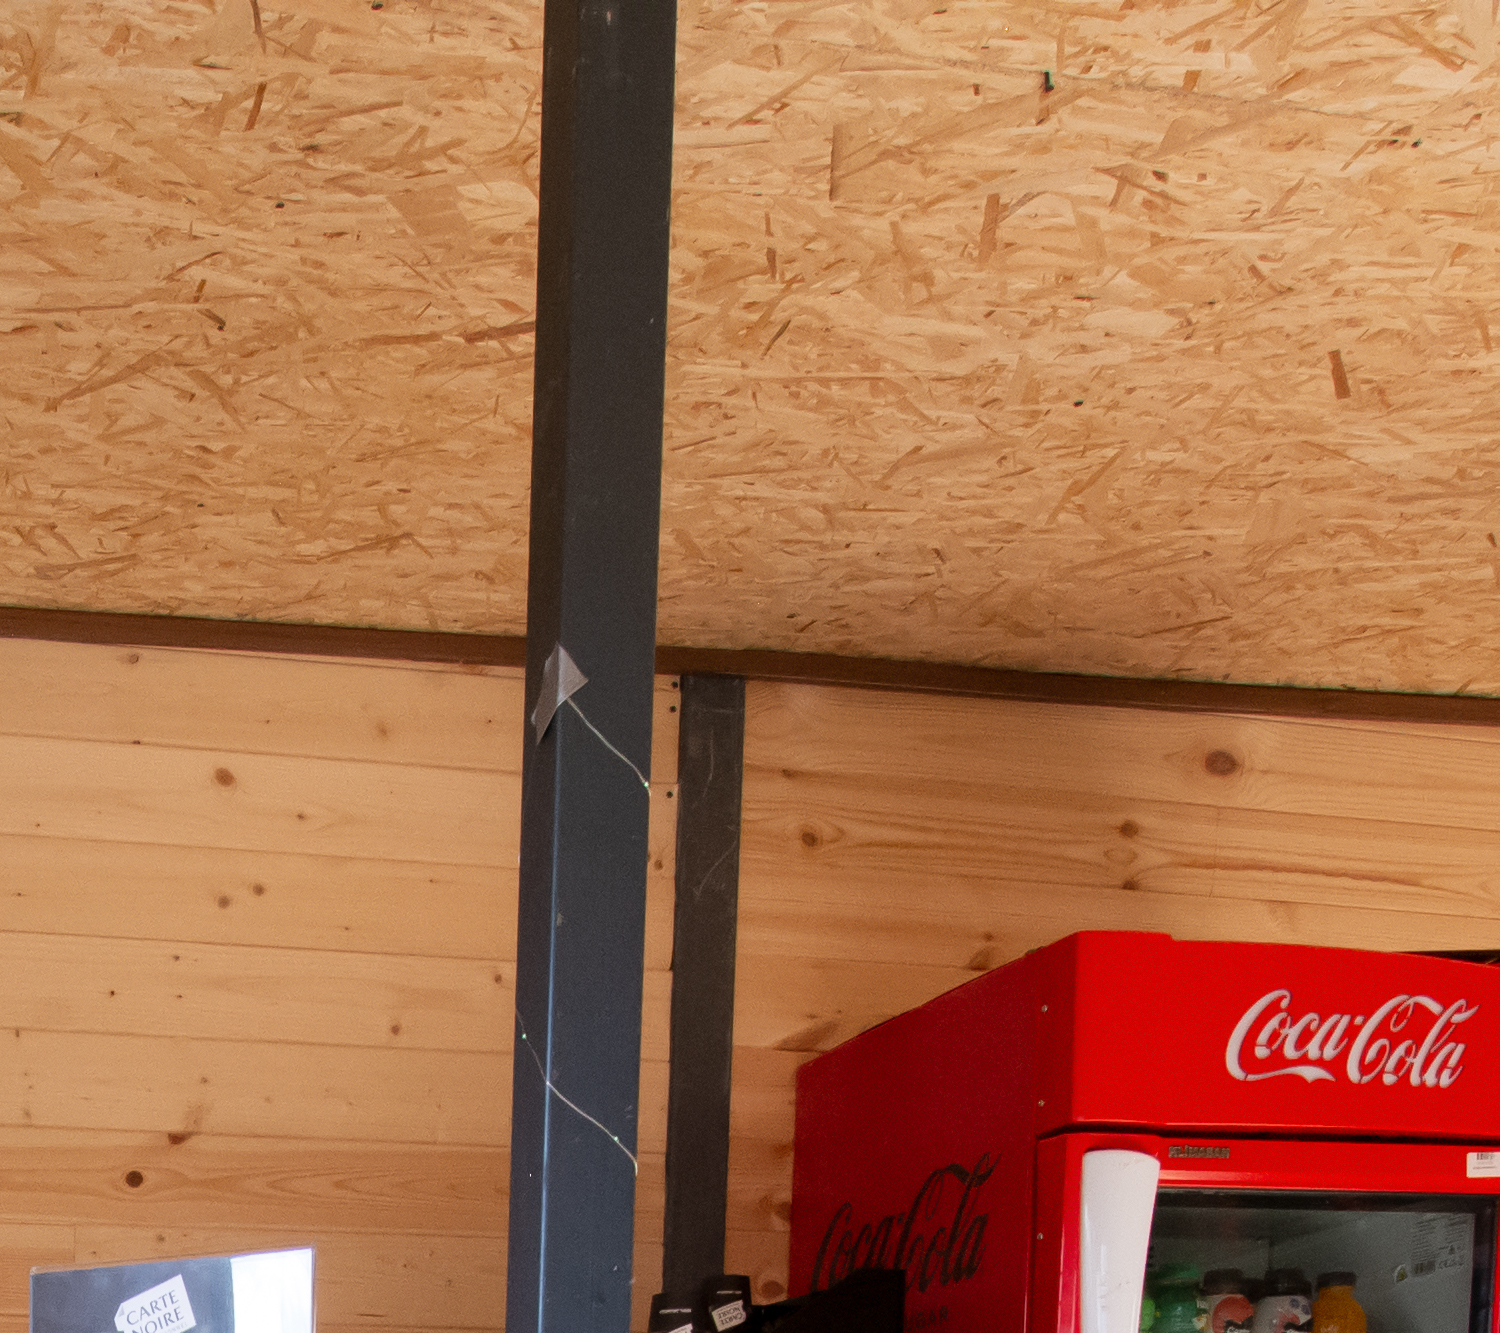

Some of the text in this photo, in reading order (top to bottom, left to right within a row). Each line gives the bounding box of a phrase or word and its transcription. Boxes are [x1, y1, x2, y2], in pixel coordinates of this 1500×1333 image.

[1225, 988, 1480, 1089] Coca-Cola
[126, 1289, 180, 1326] CARTE
[904, 1305, 949, 1333] UGAR
